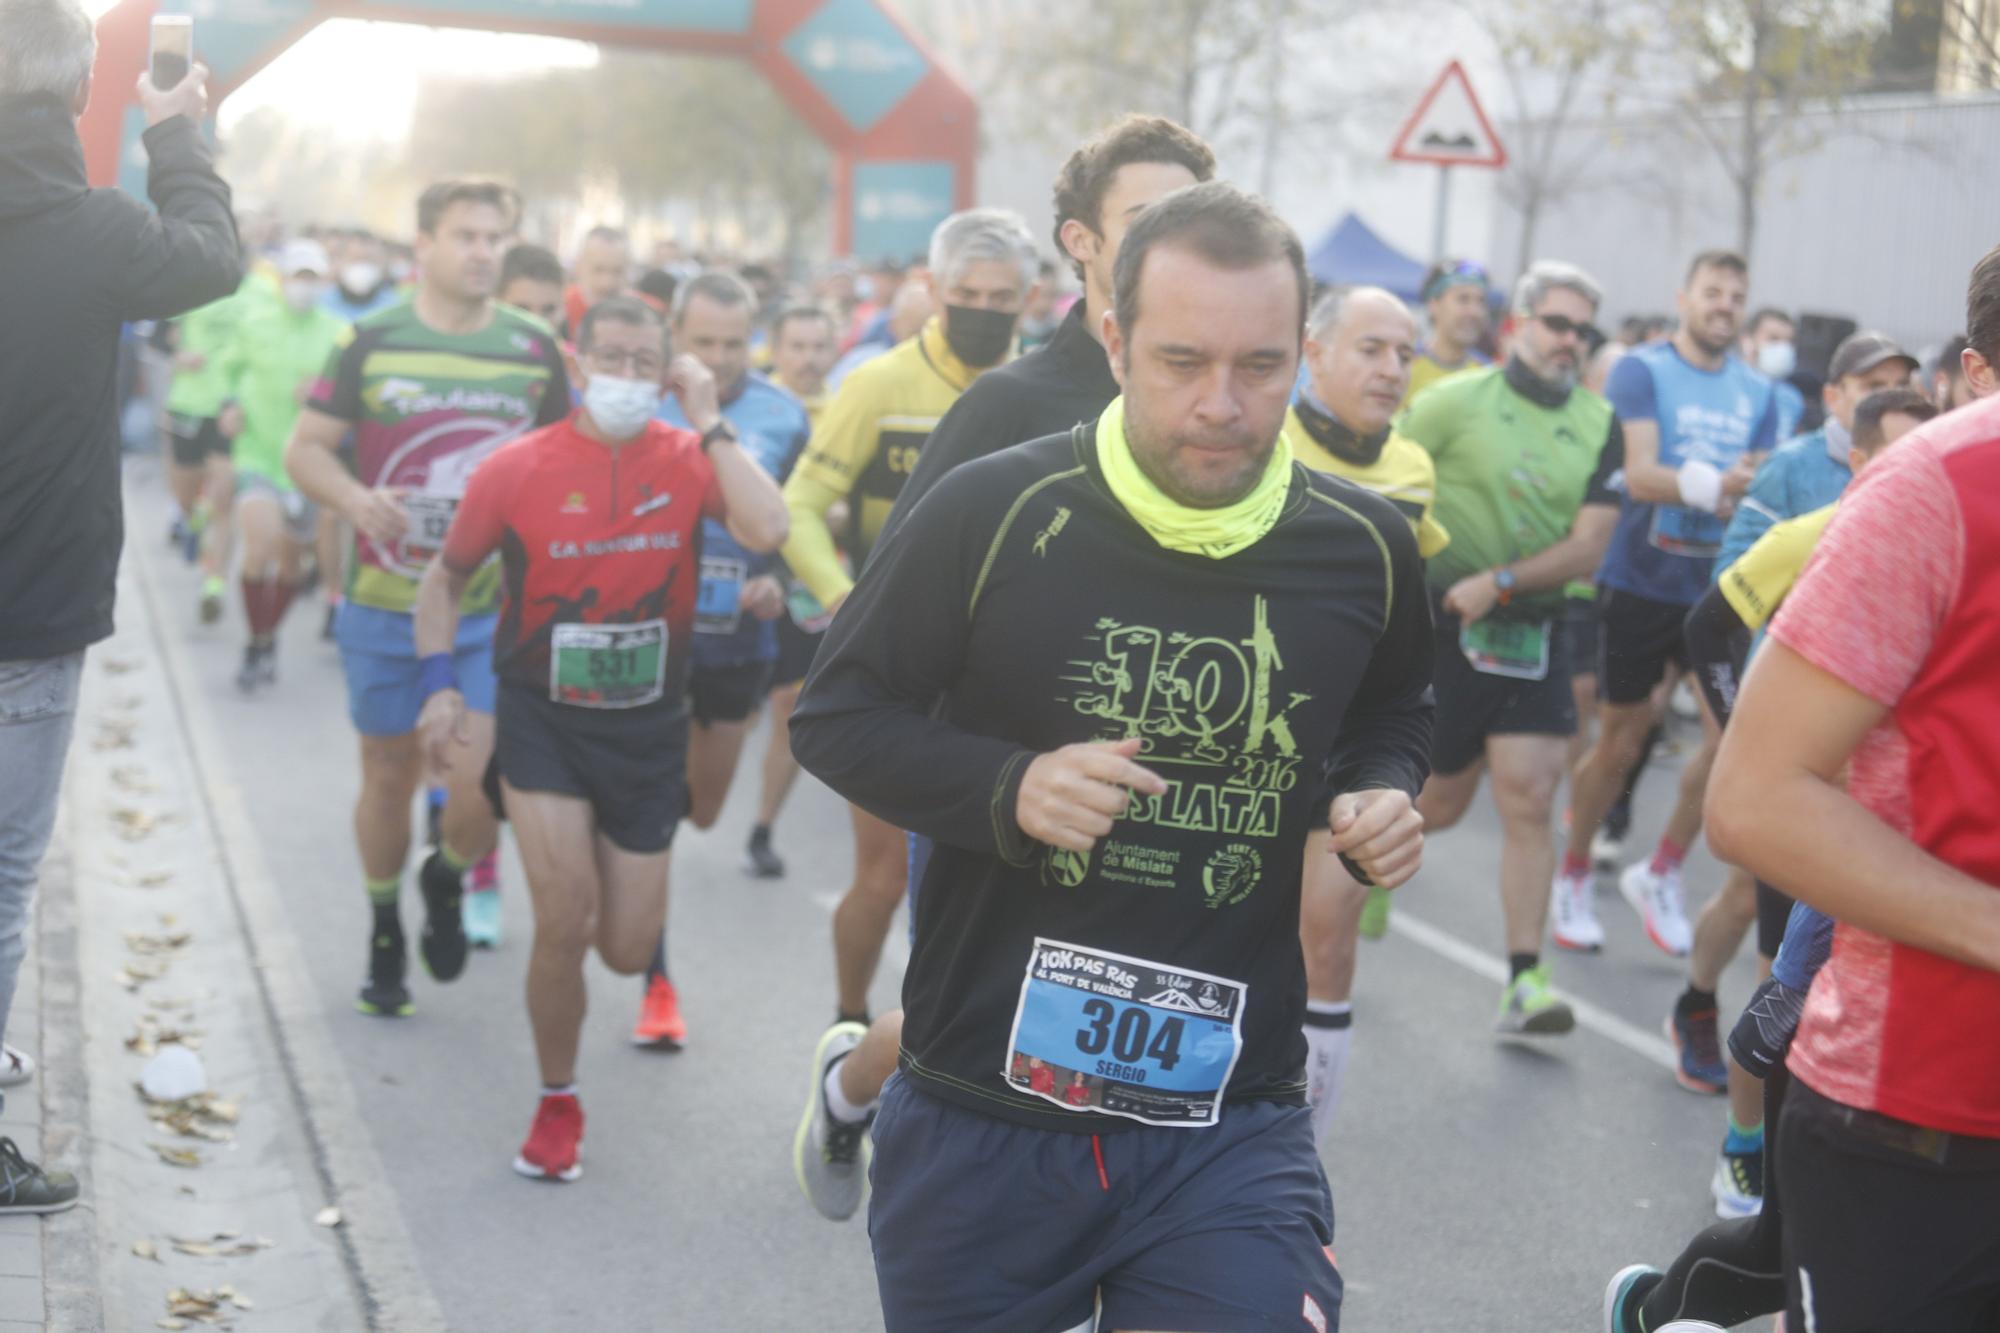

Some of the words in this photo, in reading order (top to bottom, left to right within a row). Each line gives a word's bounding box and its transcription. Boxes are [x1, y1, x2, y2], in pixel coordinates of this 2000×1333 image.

[588, 648, 637, 680] 531
[1226, 755, 1303, 792] 2016
[1102, 852, 1120, 868] de
[1122, 854, 1175, 876] Mislata
[1104, 839, 1181, 864] Ajuntament
[1036, 969, 1048, 980] AL
[1049, 971, 1075, 986] PORT
[1077, 977, 1091, 989] DE
[1040, 949, 1074, 970] 10K
[1073, 956, 1106, 976] PAS
[1106, 965, 1138, 989] RAS
[1075, 998, 1187, 1072] 304
[1095, 1059, 1147, 1084] SERGIO
